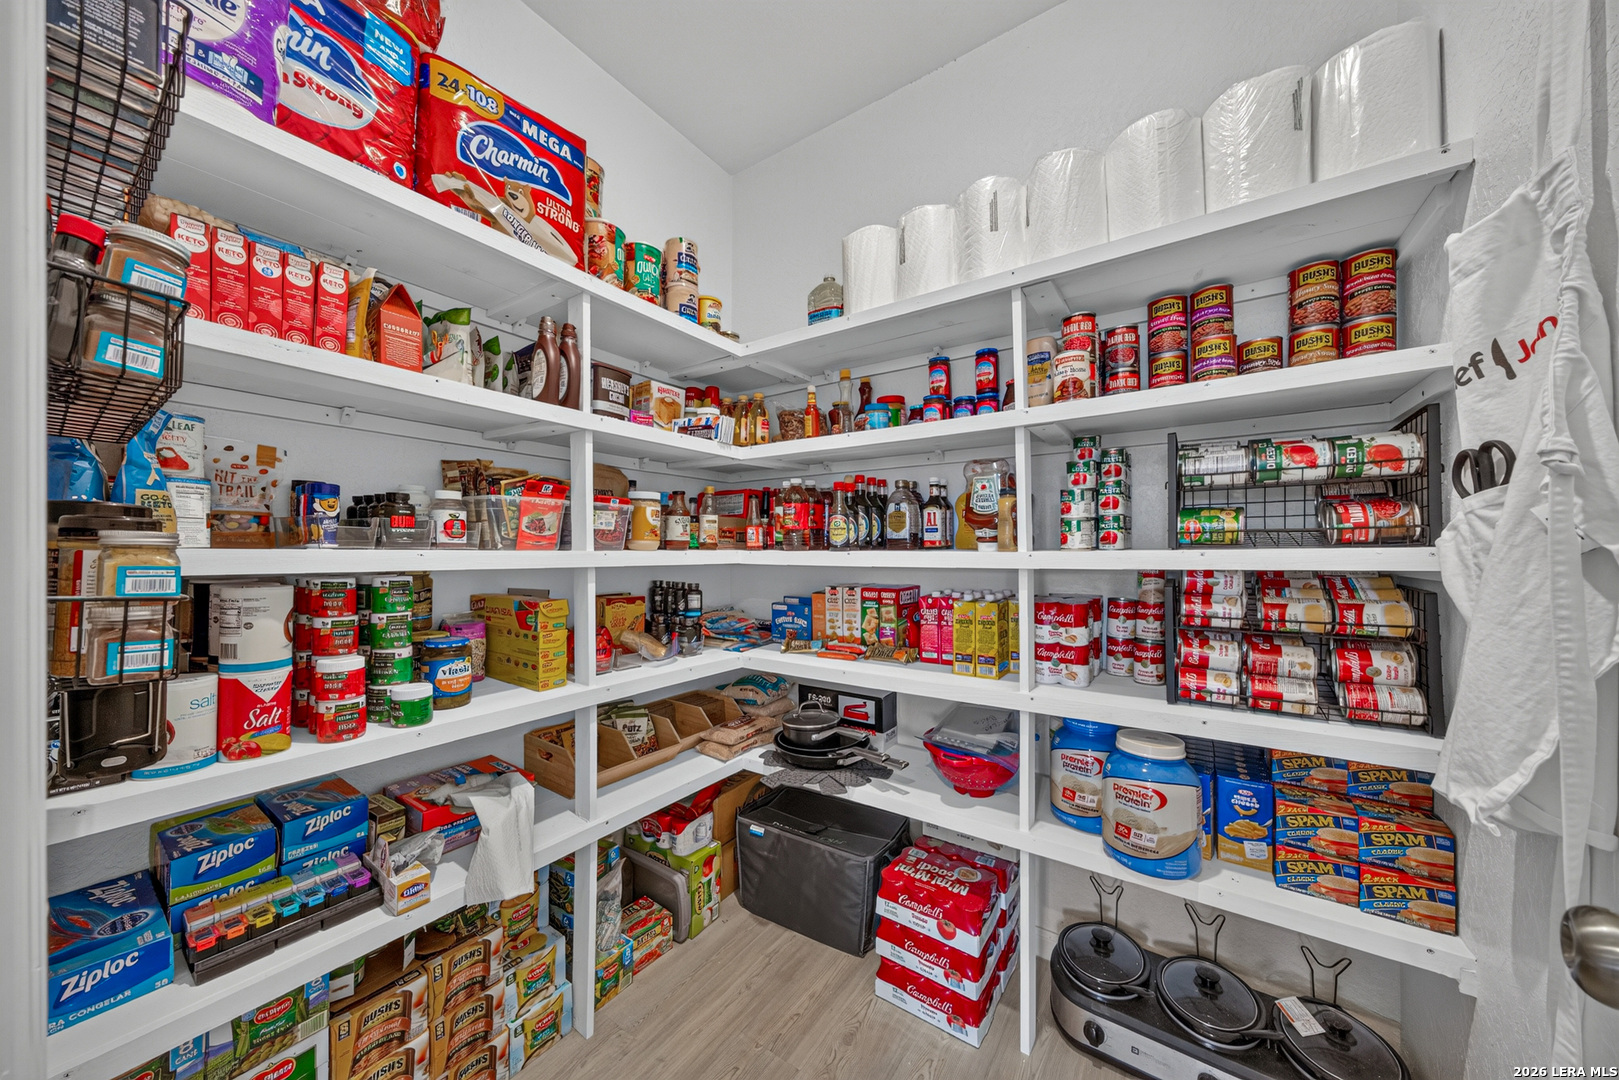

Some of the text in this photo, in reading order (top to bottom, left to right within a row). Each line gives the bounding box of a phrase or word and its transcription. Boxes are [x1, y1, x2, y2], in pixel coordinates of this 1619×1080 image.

[374, 28, 404, 55] NEW
[293, 70, 364, 119] Strong
[437, 72, 500, 115] 24 108
[521, 117, 572, 162] MEGA
[469, 134, 551, 184] Charmin
[546, 197, 572, 218] ULTRA
[537, 202, 580, 234] STRONG
[177, 233, 205, 247] KETO
[217, 246, 244, 259] KETO
[256, 255, 280, 269] KETO
[1354, 256, 1391, 272] BUSH'S
[288, 270, 311, 282] KETO
[1302, 268, 1335, 282] BUSH'S
[323, 278, 344, 290] KETO
[1195, 292, 1225, 307] BUSH'S
[1354, 325, 1391, 340] BUSH'S
[1197, 342, 1228, 356] BUSH'S
[1296, 334, 1330, 349] BUSH'S
[1244, 344, 1277, 357] BUSH'S
[1455, 351, 1485, 387] ef
[172, 420, 196, 431] LEAF
[190, 692, 216, 711] salt
[243, 706, 283, 730] Salt
[1060, 753, 1095, 767] premier
[1062, 760, 1092, 775] protein
[1282, 756, 1327, 769] SPAM
[1358, 770, 1408, 782] SPAM
[1113, 783, 1154, 801] premier
[1115, 791, 1152, 808] protein
[304, 805, 352, 837] Ziploc
[1286, 816, 1335, 828] SPAM
[1371, 833, 1427, 847] SPAM
[197, 837, 255, 874] Ziploc
[1286, 861, 1335, 875] SPAM
[1372, 885, 1429, 900] SPAM
[898, 892, 943, 919] Campbell's
[453, 947, 482, 970] BUSH'S
[904, 938, 949, 969] Campbell's
[58, 951, 139, 1002] Ziploc
[907, 982, 953, 1014] Campbell's
[48, 990, 132, 1029] RA CONGELAR
[363, 1000, 401, 1028] BUSH'S
[454, 1002, 485, 1029] BUSH'S
[460, 1053, 488, 1078] BUSH'S
